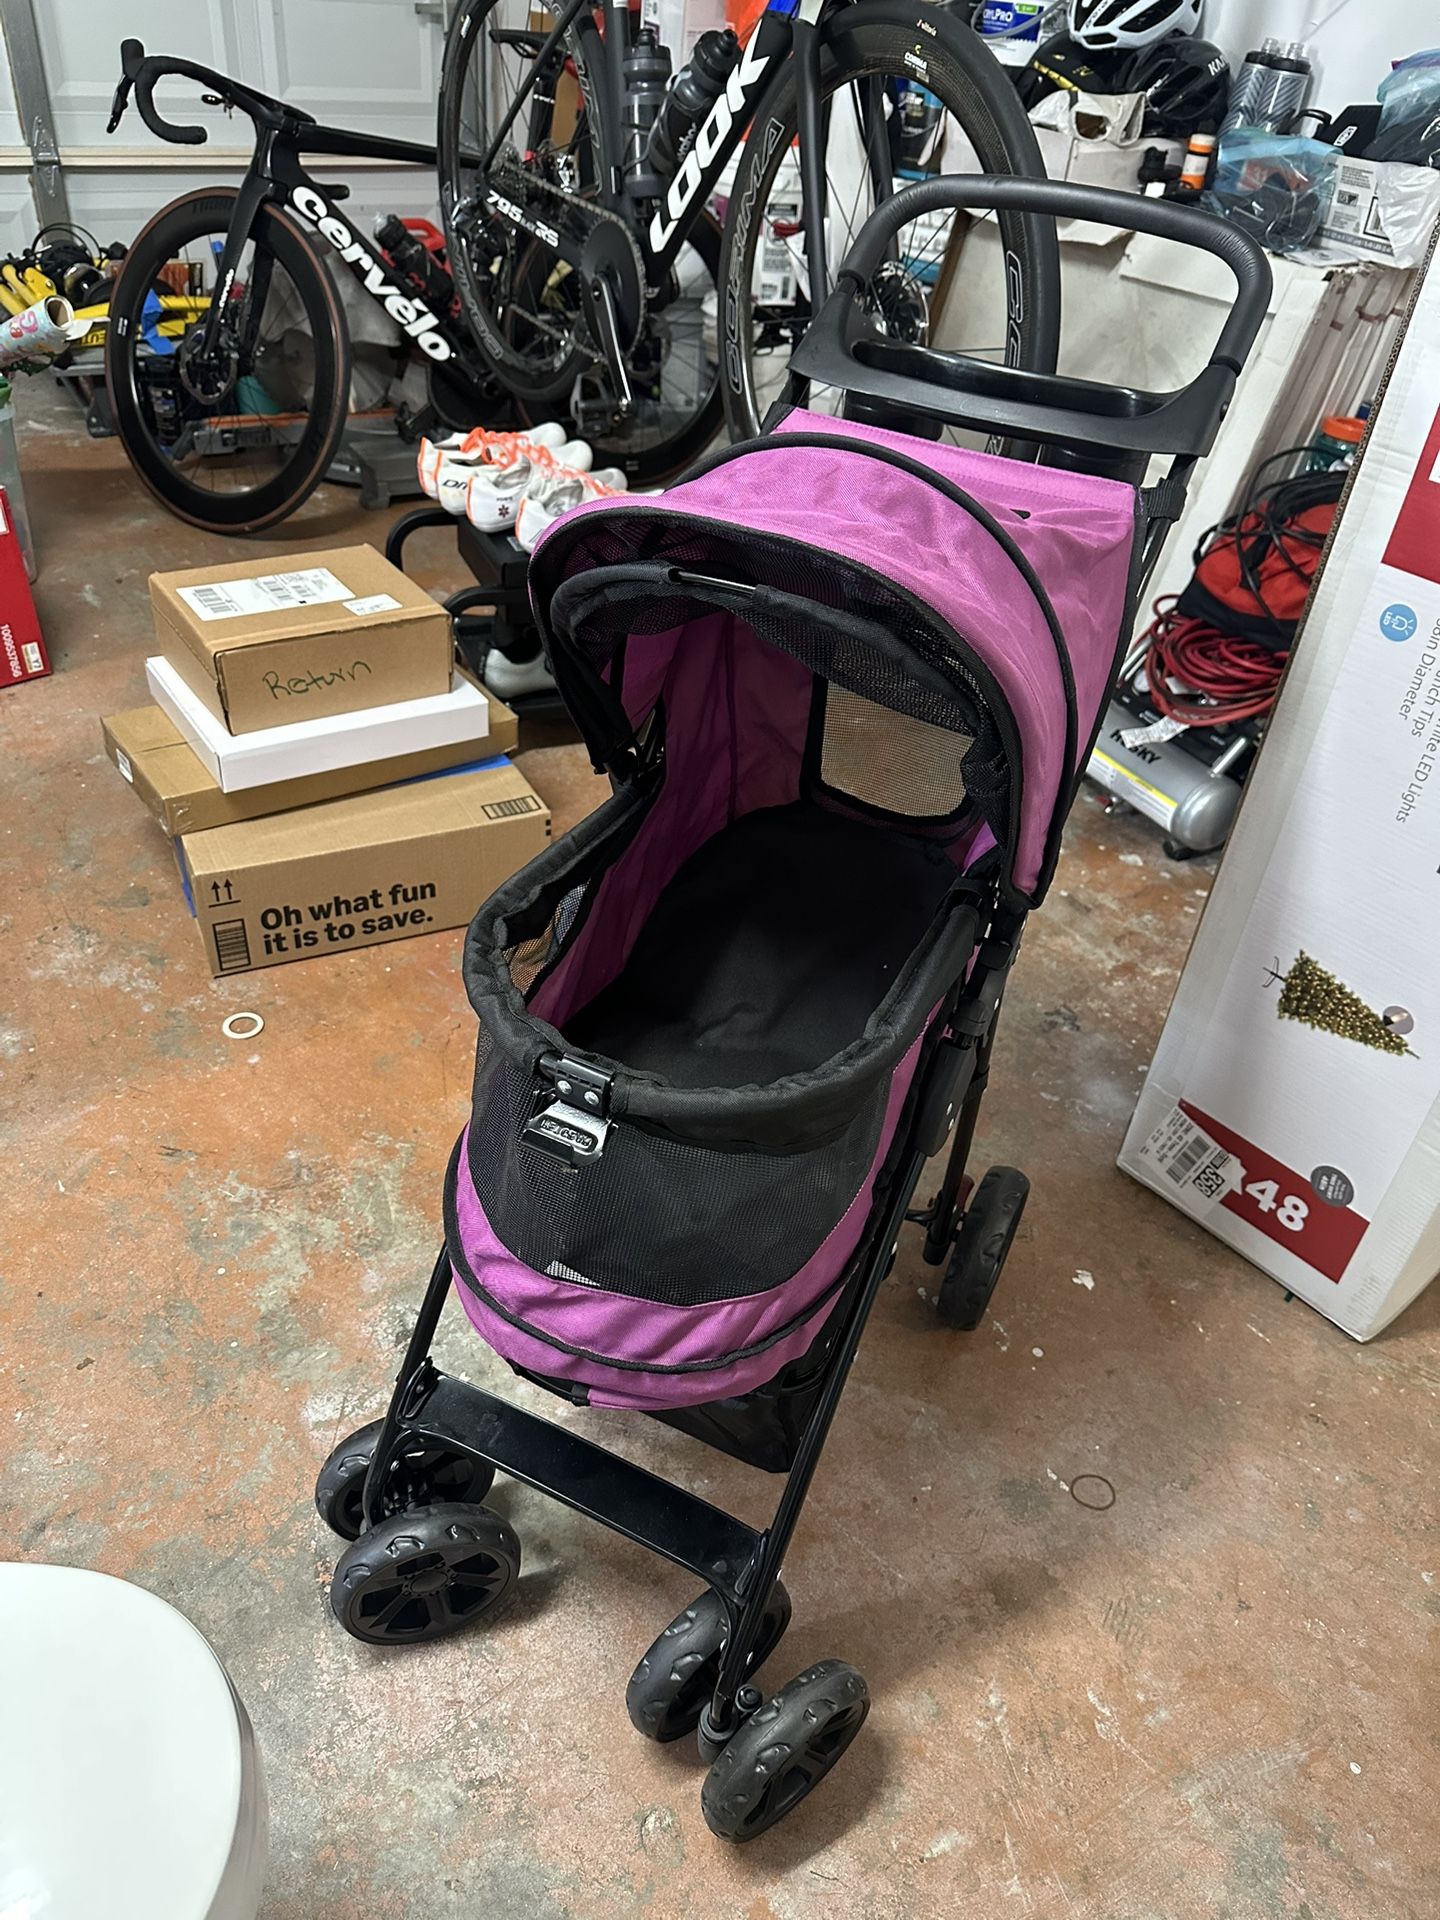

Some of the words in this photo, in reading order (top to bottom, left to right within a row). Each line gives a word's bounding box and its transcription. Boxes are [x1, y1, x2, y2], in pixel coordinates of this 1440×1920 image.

[649, 19, 770, 253] LOOK
[487, 189, 523, 223] 795
[262, 660, 372, 699] Return
[1399, 653, 1436, 720] Diameter
[1411, 710, 1434, 738] Tips
[1414, 754, 1436, 782] LED
[1396, 782, 1423, 823] Lights
[260, 904, 302, 931] Oh
[309, 892, 382, 921] what
[389, 882, 436, 906] fun
[263, 931, 288, 955] it
[294, 927, 318, 950] is
[324, 920, 355, 943] to
[363, 907, 433, 933] save.
[1194, 1165, 1225, 1197] 358
[1245, 1180, 1309, 1232] 48
